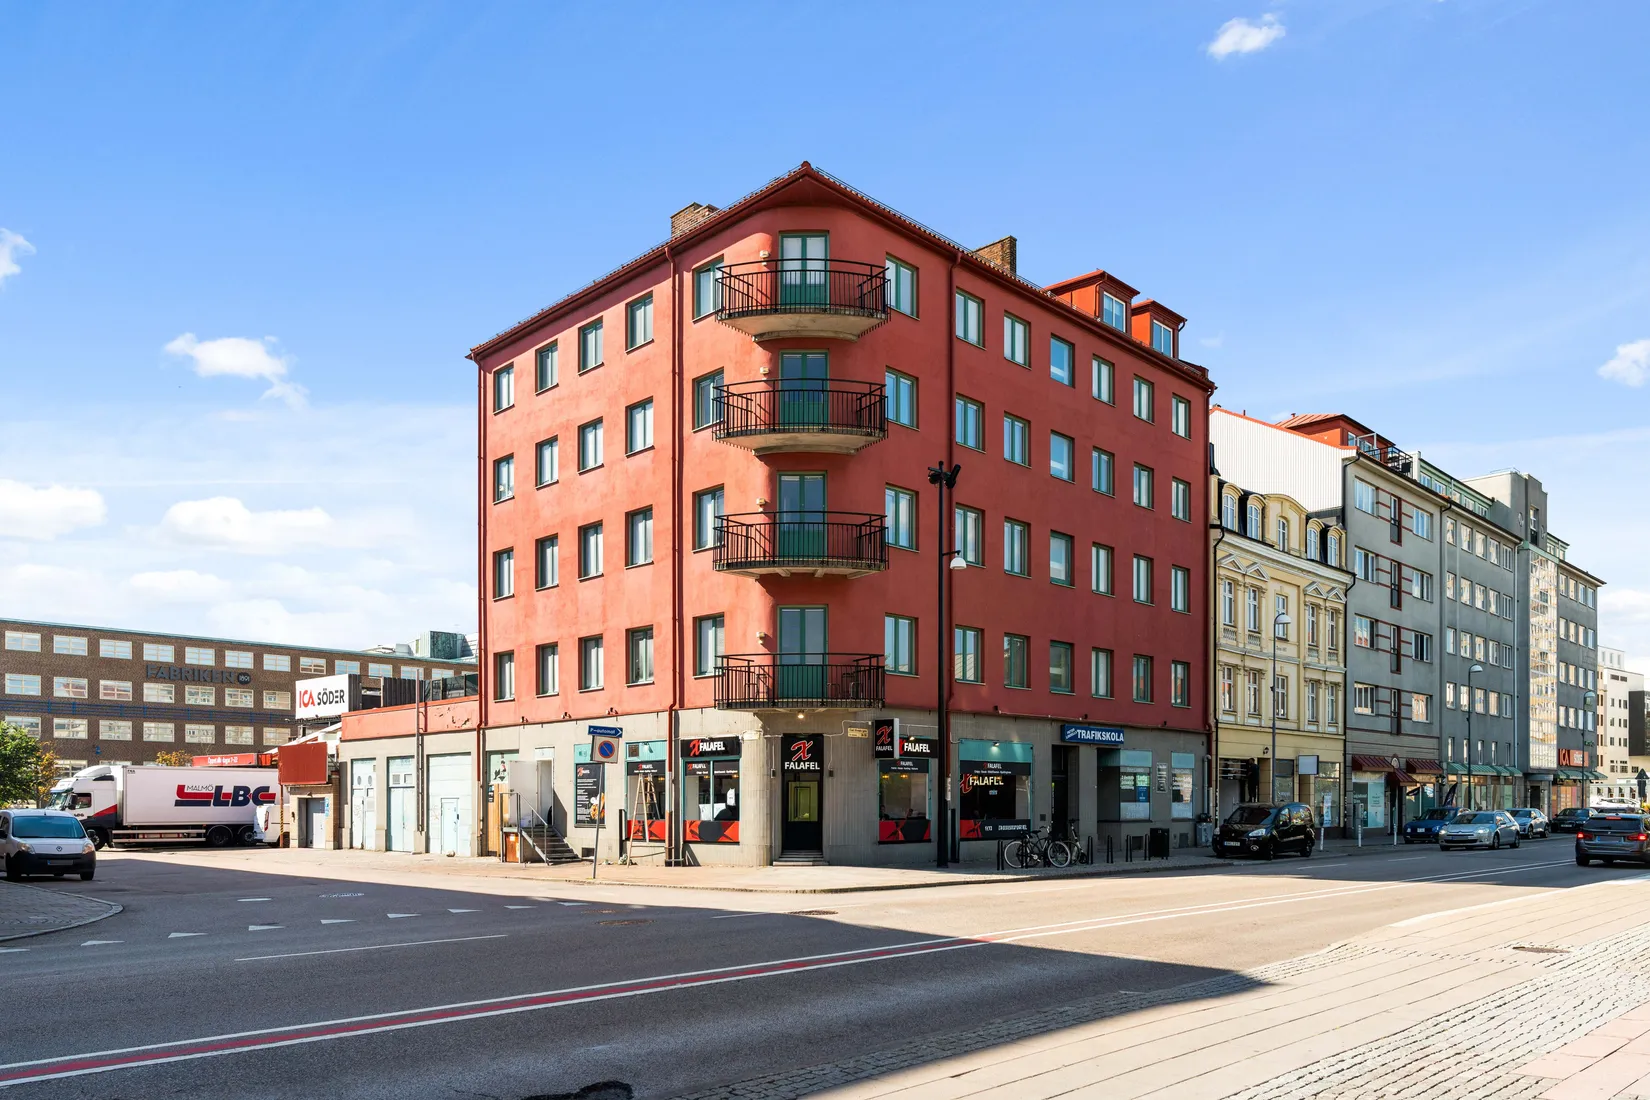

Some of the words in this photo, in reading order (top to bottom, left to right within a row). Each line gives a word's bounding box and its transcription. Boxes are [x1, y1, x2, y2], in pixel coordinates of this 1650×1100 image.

[147, 664, 235, 684] FABRIKEN
[299, 690, 316, 708] ICA
[317, 688, 345, 706] SÖDER
[1076, 729, 1124, 742] TRAFIKSKOLA
[699, 741, 726, 752] FALAFEL
[904, 742, 931, 753] FALAFEL
[1560, 749, 1570, 766] ICA
[784, 761, 821, 770] FALAFEL
[186, 784, 214, 792] MALMÖ
[212, 785, 276, 807] LBC
